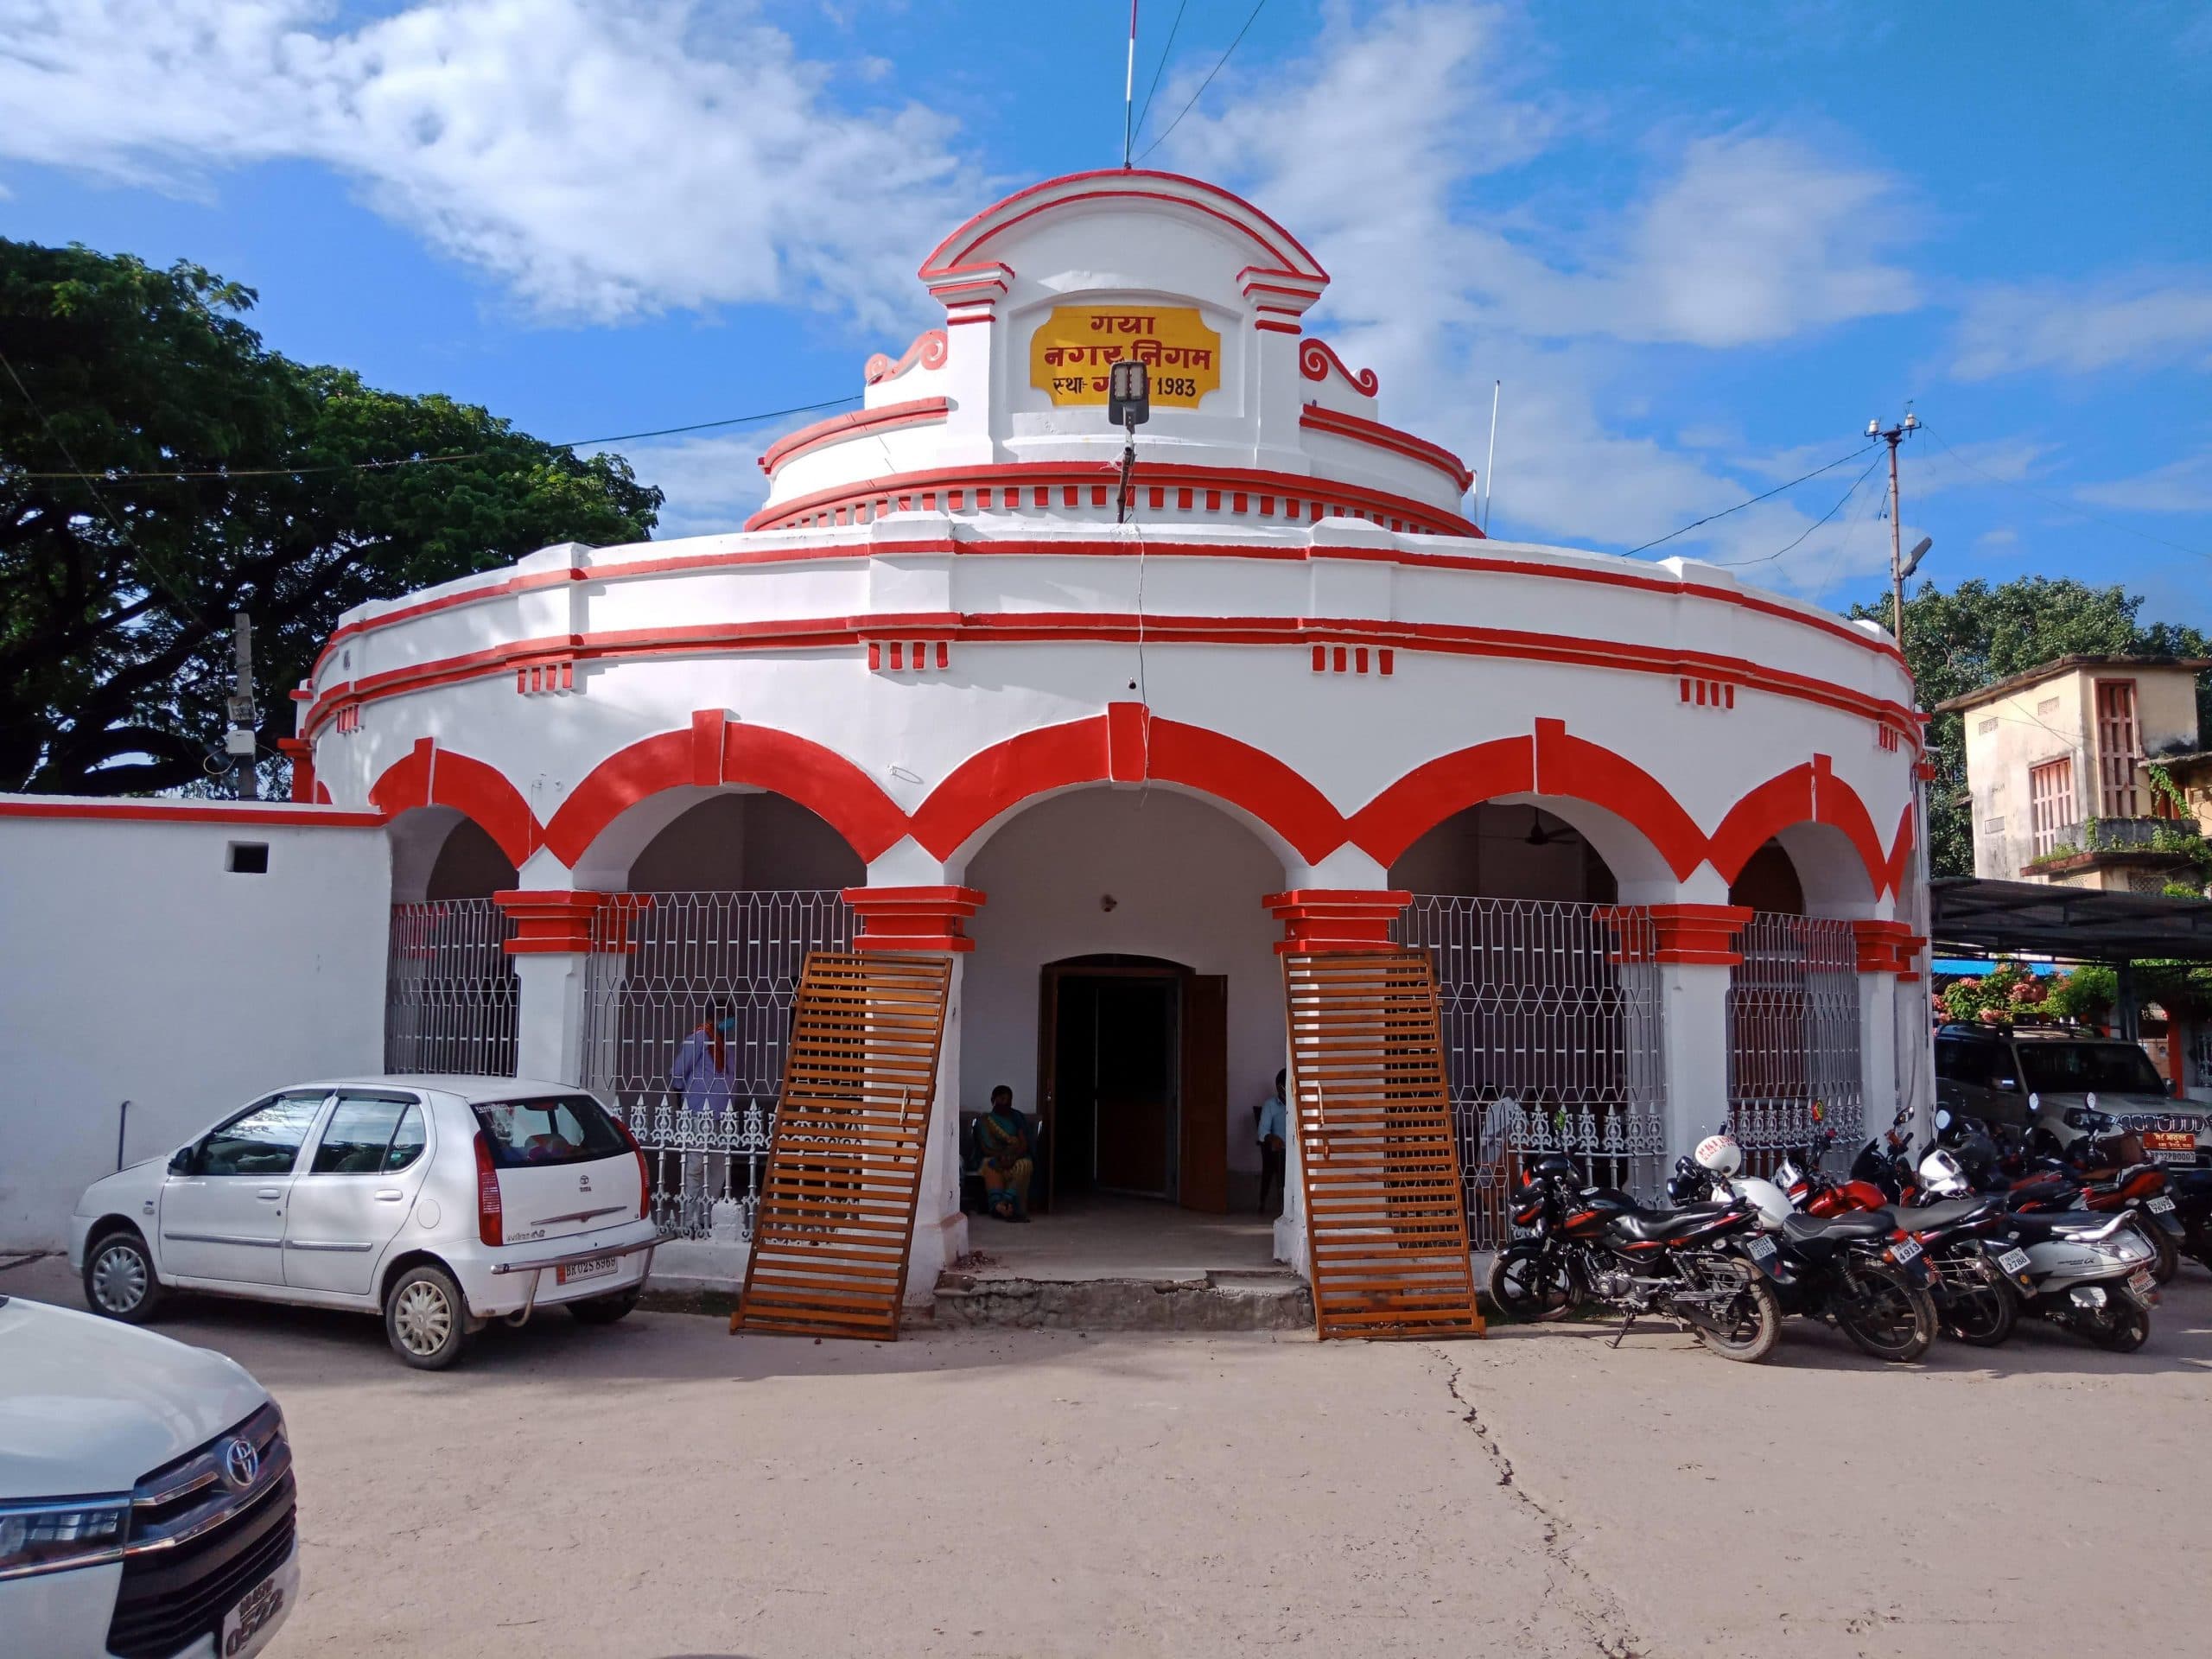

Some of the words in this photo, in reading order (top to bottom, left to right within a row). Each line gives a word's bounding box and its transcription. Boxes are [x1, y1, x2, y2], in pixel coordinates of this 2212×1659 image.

[1090, 315, 1156, 334] गया
[1044, 346, 1123, 367] नगर
[1131, 340, 1212, 370] निगम
[1157, 377, 1197, 397] 1983
[1899, 1243, 1920, 1260] 4913
[2007, 1255, 2027, 1271] 2788
